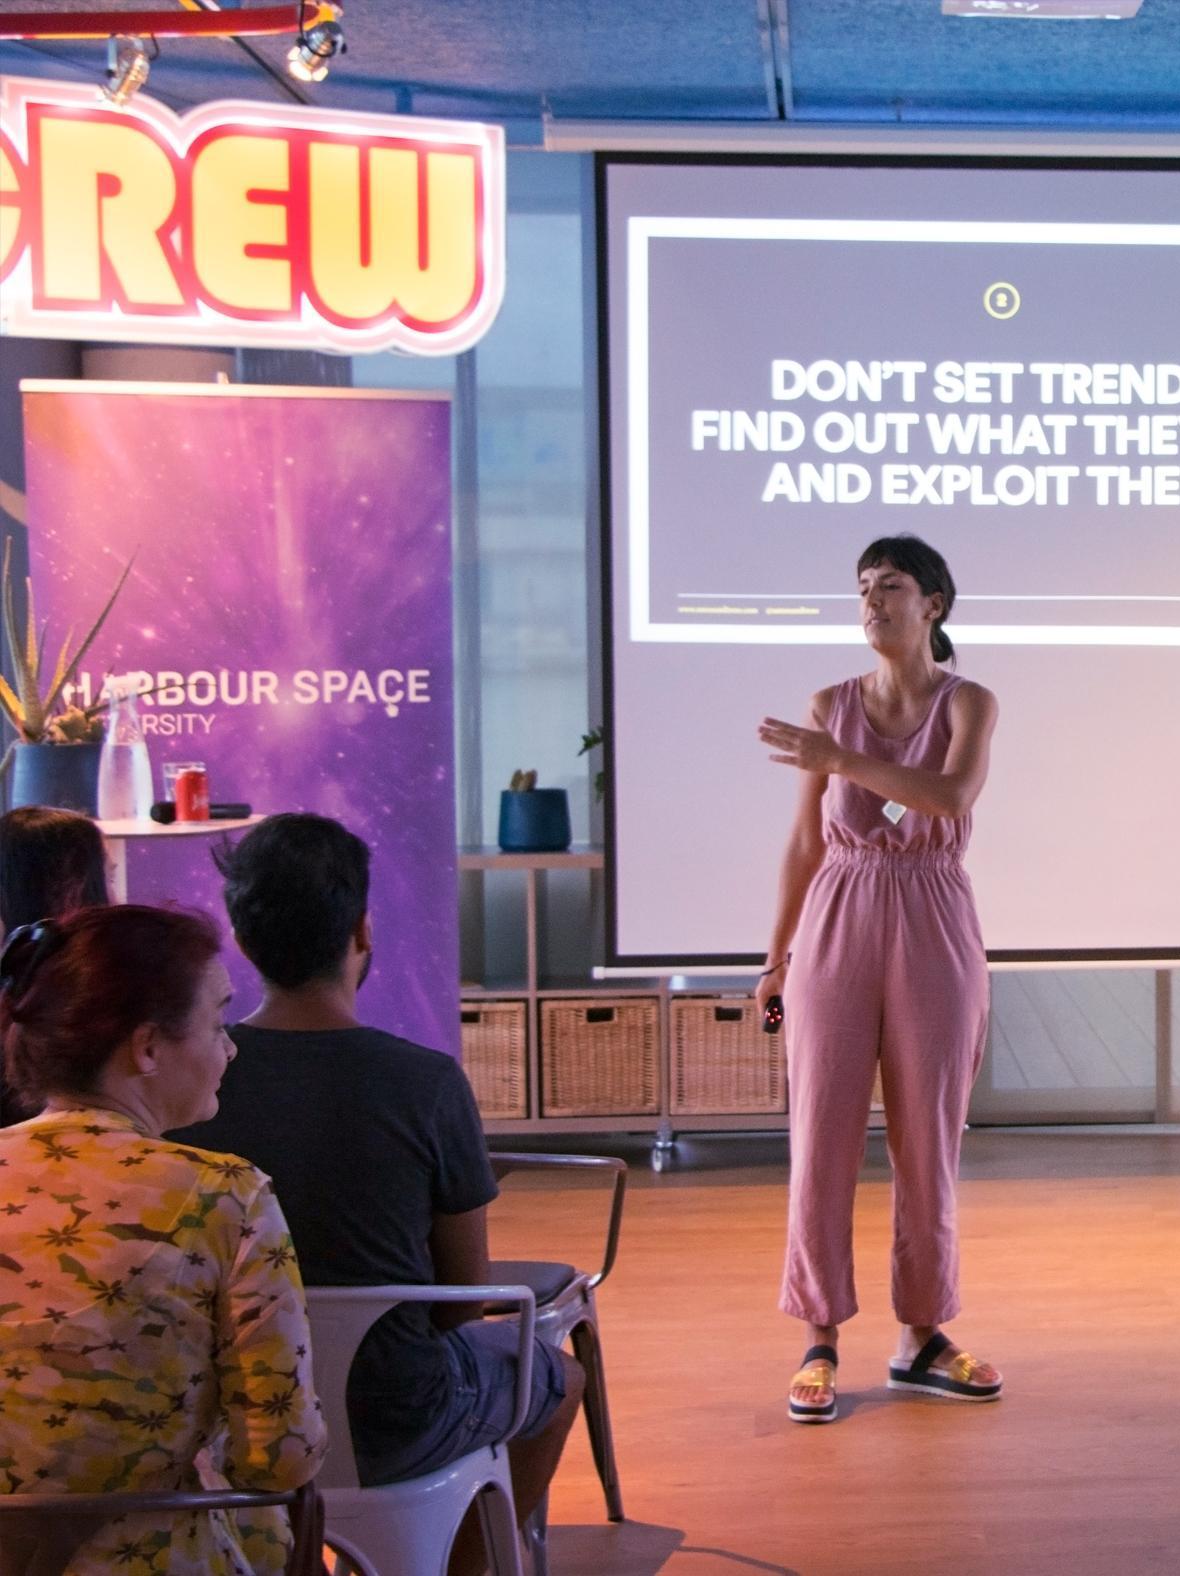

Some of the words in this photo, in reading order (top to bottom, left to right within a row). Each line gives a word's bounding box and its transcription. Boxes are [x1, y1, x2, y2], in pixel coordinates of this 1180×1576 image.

[0, 106, 484, 330] REW
[771, 359, 927, 402] DON’T
[933, 361, 1024, 403] SET
[692, 410, 806, 451] FIND
[813, 411, 920, 453] OUT
[925, 413, 1078, 454] WHAT
[762, 462, 872, 503] AND
[881, 464, 1080, 506] EXPLOIT
